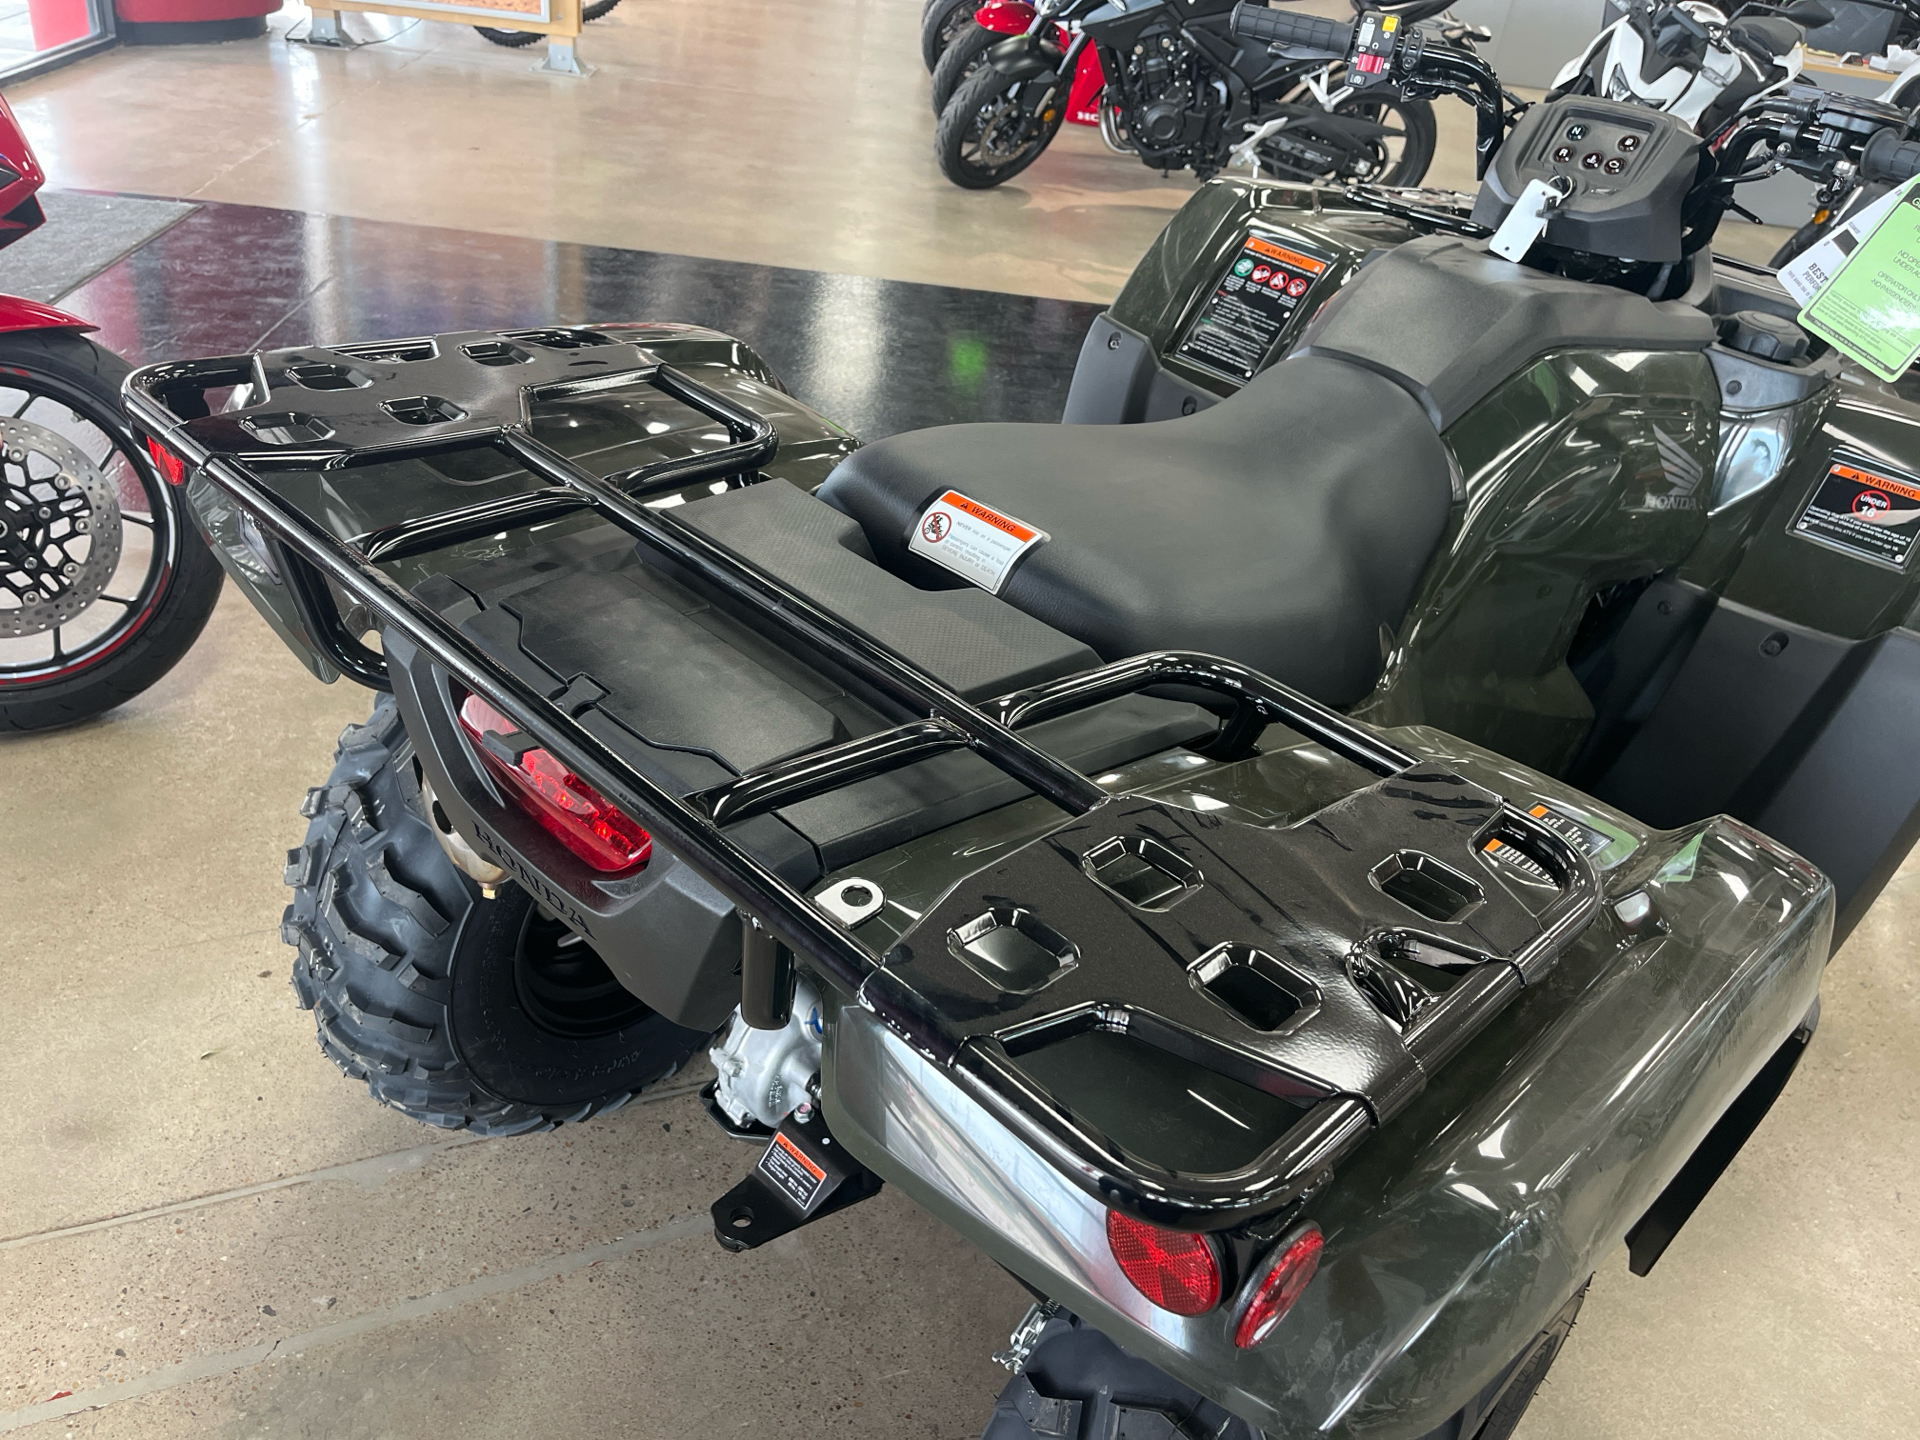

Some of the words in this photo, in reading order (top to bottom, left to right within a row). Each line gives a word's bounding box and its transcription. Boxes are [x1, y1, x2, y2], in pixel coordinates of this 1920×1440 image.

[1559, 148, 1568, 156] R
[1268, 247, 1304, 265] WARNING
[1892, 255, 1914, 274] UNDER
[1808, 262, 1829, 283] BEST
[1876, 269, 1907, 294] OPERATOR
[1863, 476, 1916, 498] WARNING
[1643, 492, 1697, 510] HONDA
[1859, 494, 1888, 509] UNDER
[1859, 504, 1877, 518] 16
[955, 520, 971, 531] NEVER
[970, 506, 1016, 532] WARNING
[941, 544, 959, 557] SEVERE
[958, 553, 975, 564] INJURY
[947, 532, 970, 547] Passengers
[977, 549, 990, 558] cause
[994, 557, 1005, 565] loss
[471, 820, 597, 941] HONDA
[788, 1144, 817, 1173] WARNING
